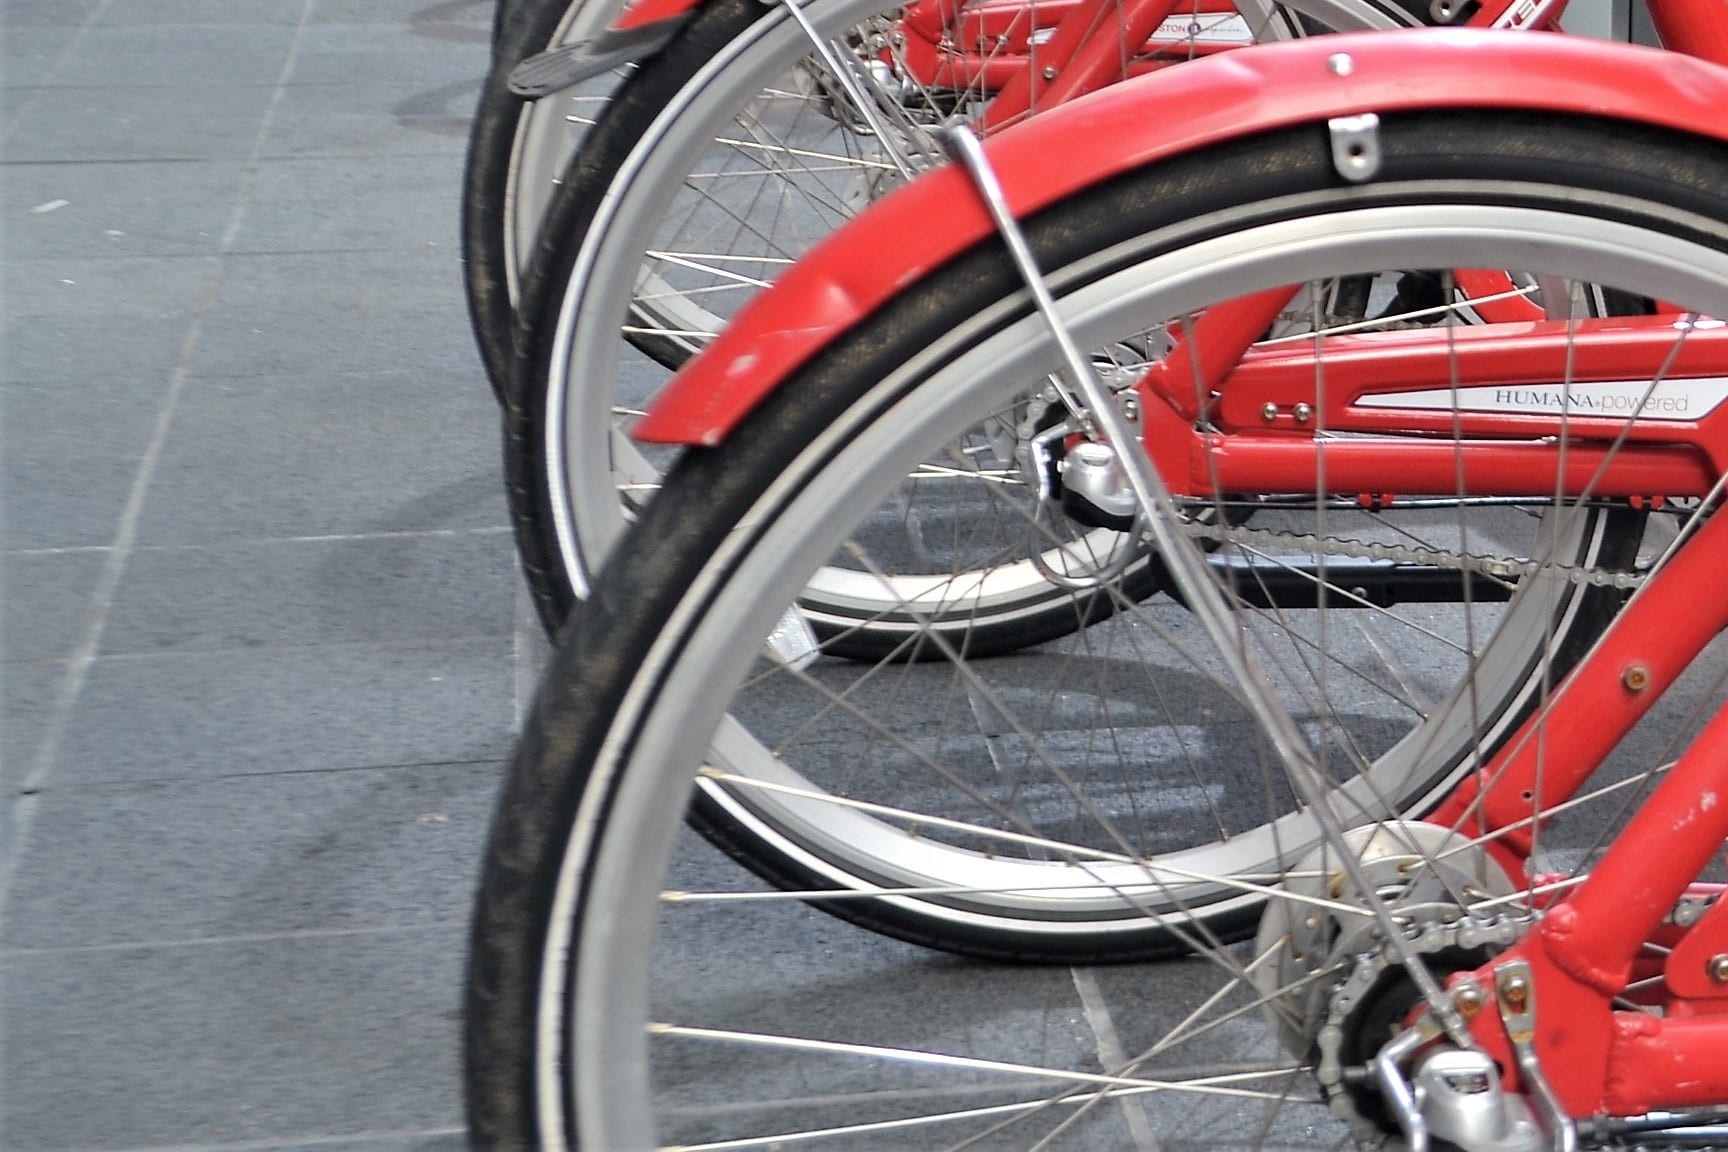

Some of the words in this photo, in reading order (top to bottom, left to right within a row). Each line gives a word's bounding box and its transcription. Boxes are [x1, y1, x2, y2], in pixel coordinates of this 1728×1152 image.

[1159, 24, 1186, 33] STON
[1495, 389, 1595, 408] HUMANA
[1601, 393, 1689, 412] powered
